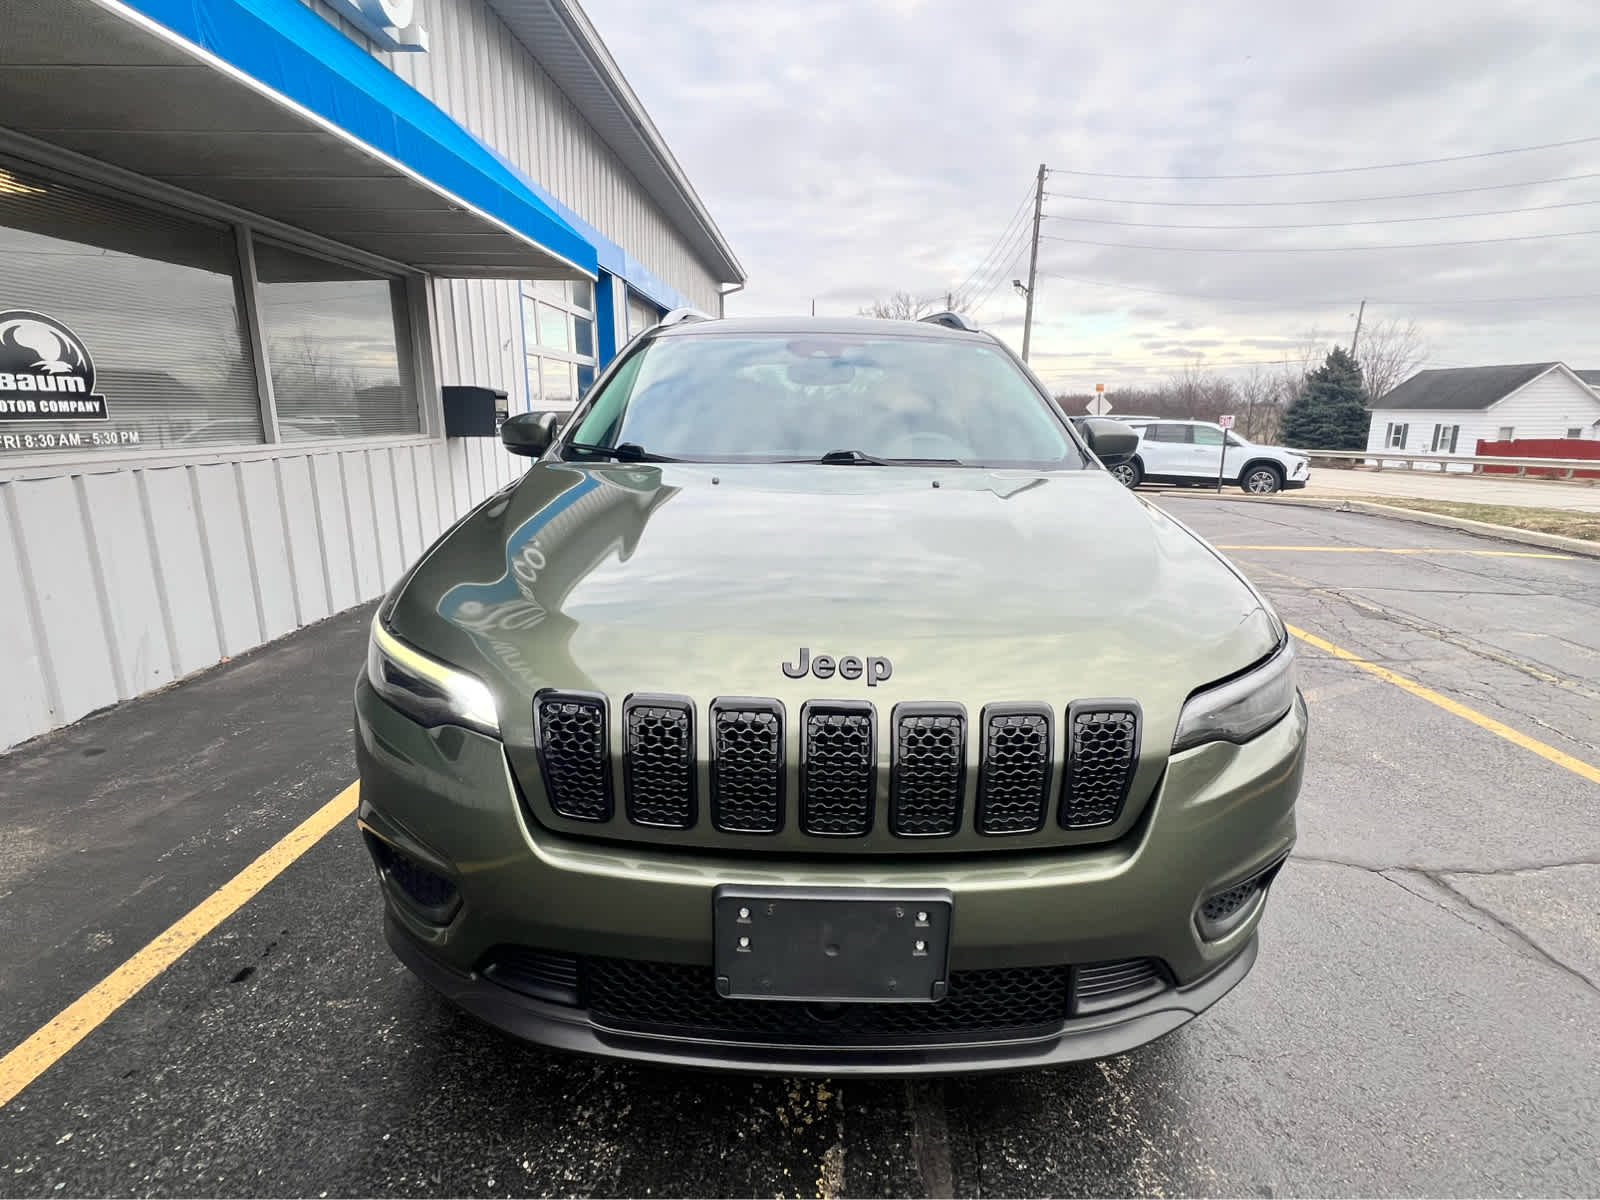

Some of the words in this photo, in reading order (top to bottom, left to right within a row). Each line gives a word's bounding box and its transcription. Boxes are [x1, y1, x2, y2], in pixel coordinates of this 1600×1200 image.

[40, 399, 100, 413] COMPANY
[24, 433, 55, 448] 8:30
[59, 432, 81, 447] AM
[92, 432, 118, 446] 5:30
[120, 431, 140, 444] PM
[782, 647, 893, 687] Jeep
